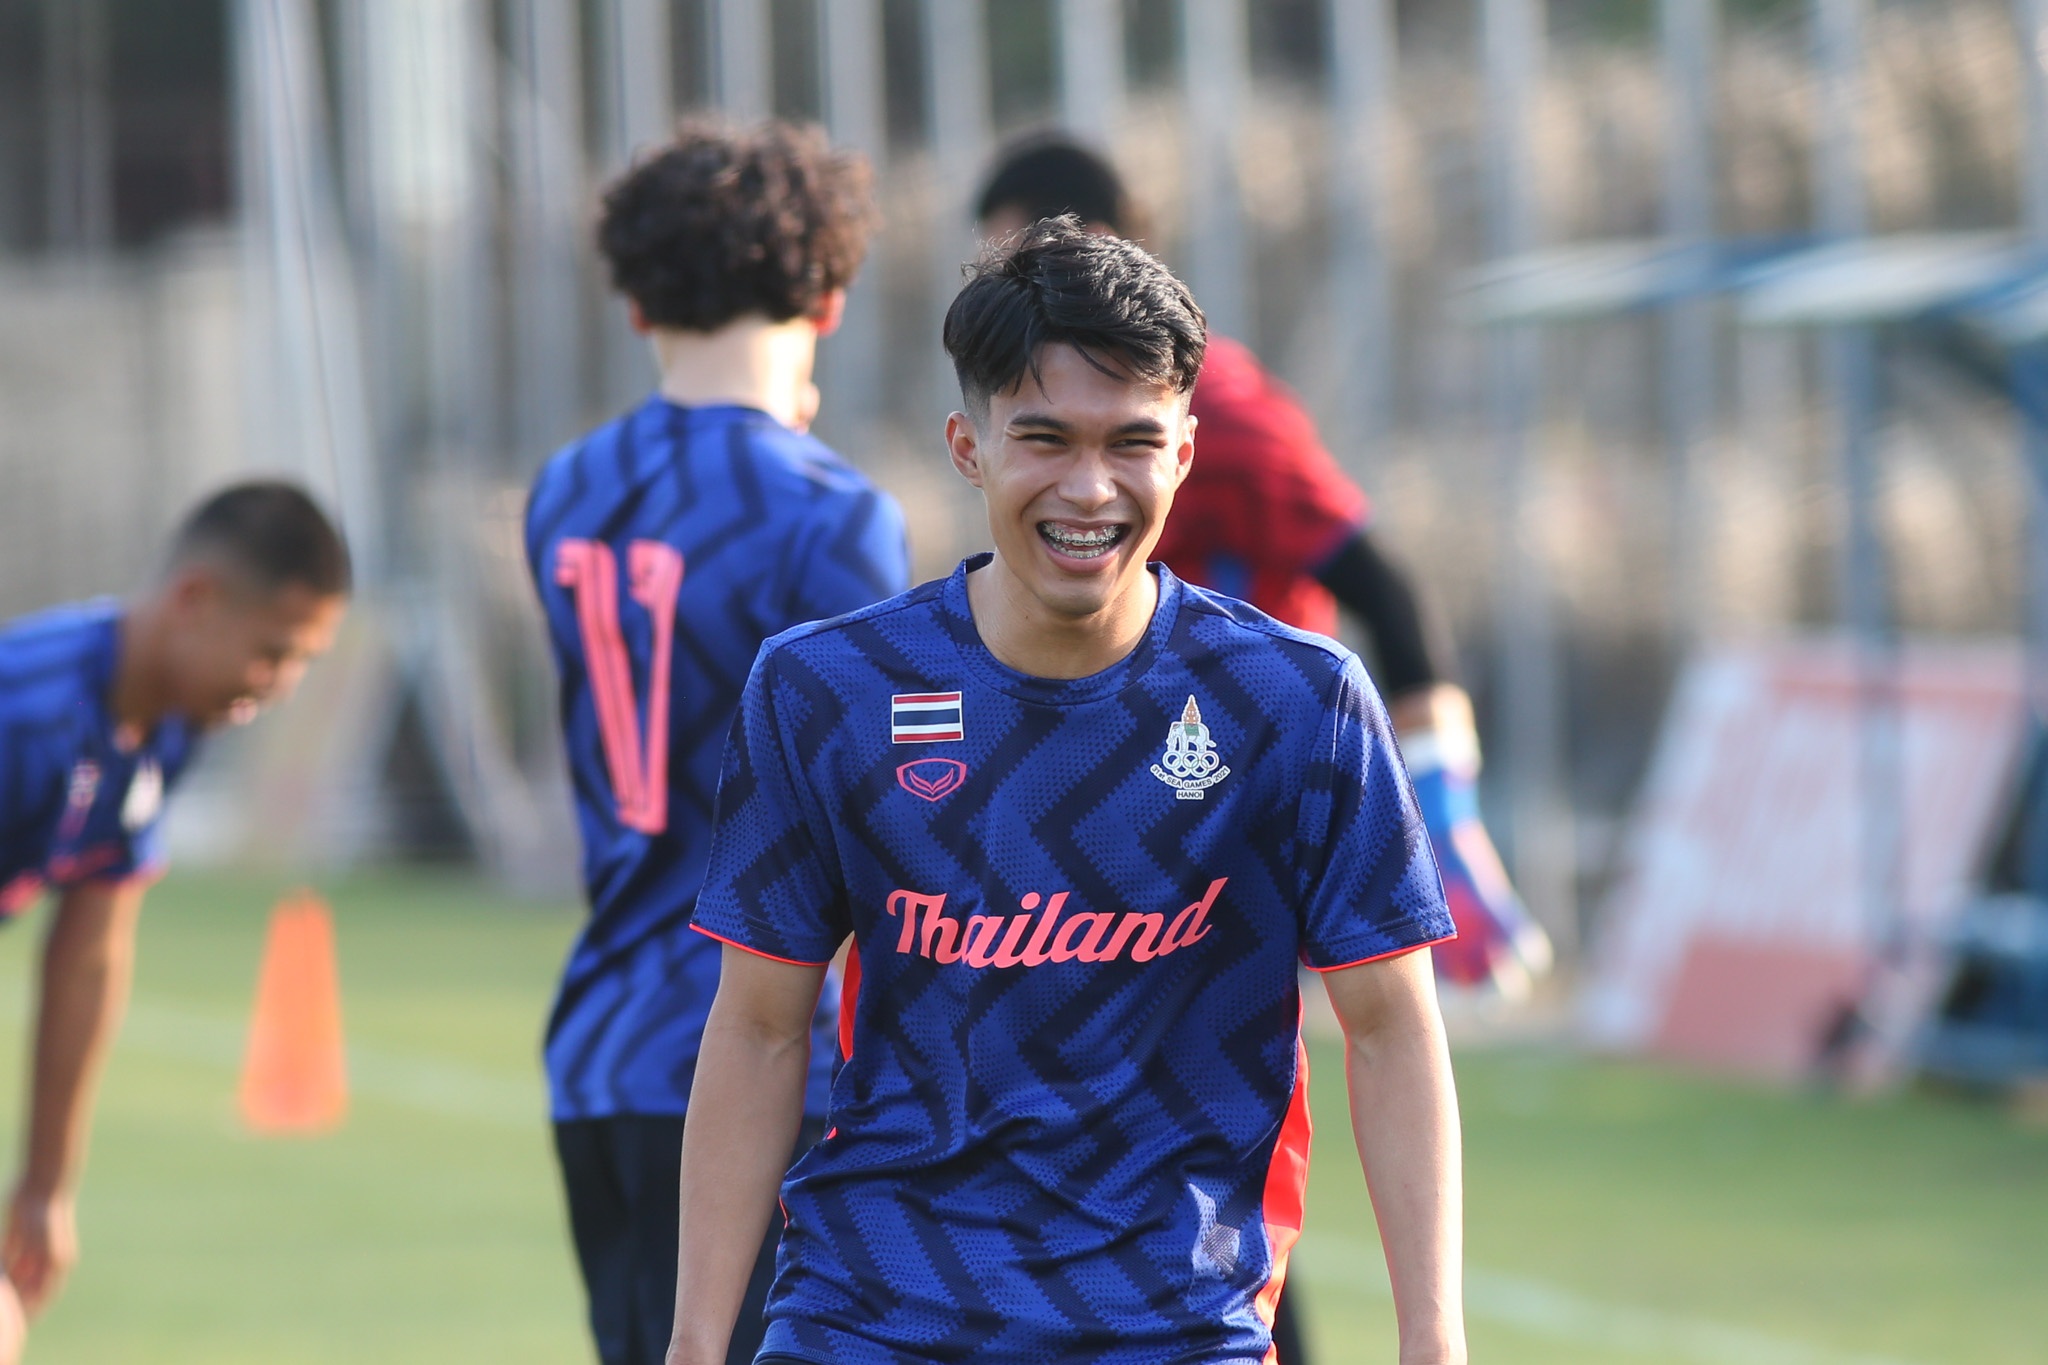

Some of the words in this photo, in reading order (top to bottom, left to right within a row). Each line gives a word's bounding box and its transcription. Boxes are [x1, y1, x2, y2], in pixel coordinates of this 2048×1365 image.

[1166, 776, 1182, 788] SEA
[1183, 778, 1213, 789] GAMES
[1213, 767, 1230, 782] 2021
[1177, 791, 1203, 799] HANOI
[886, 876, 1229, 969] Thailand
